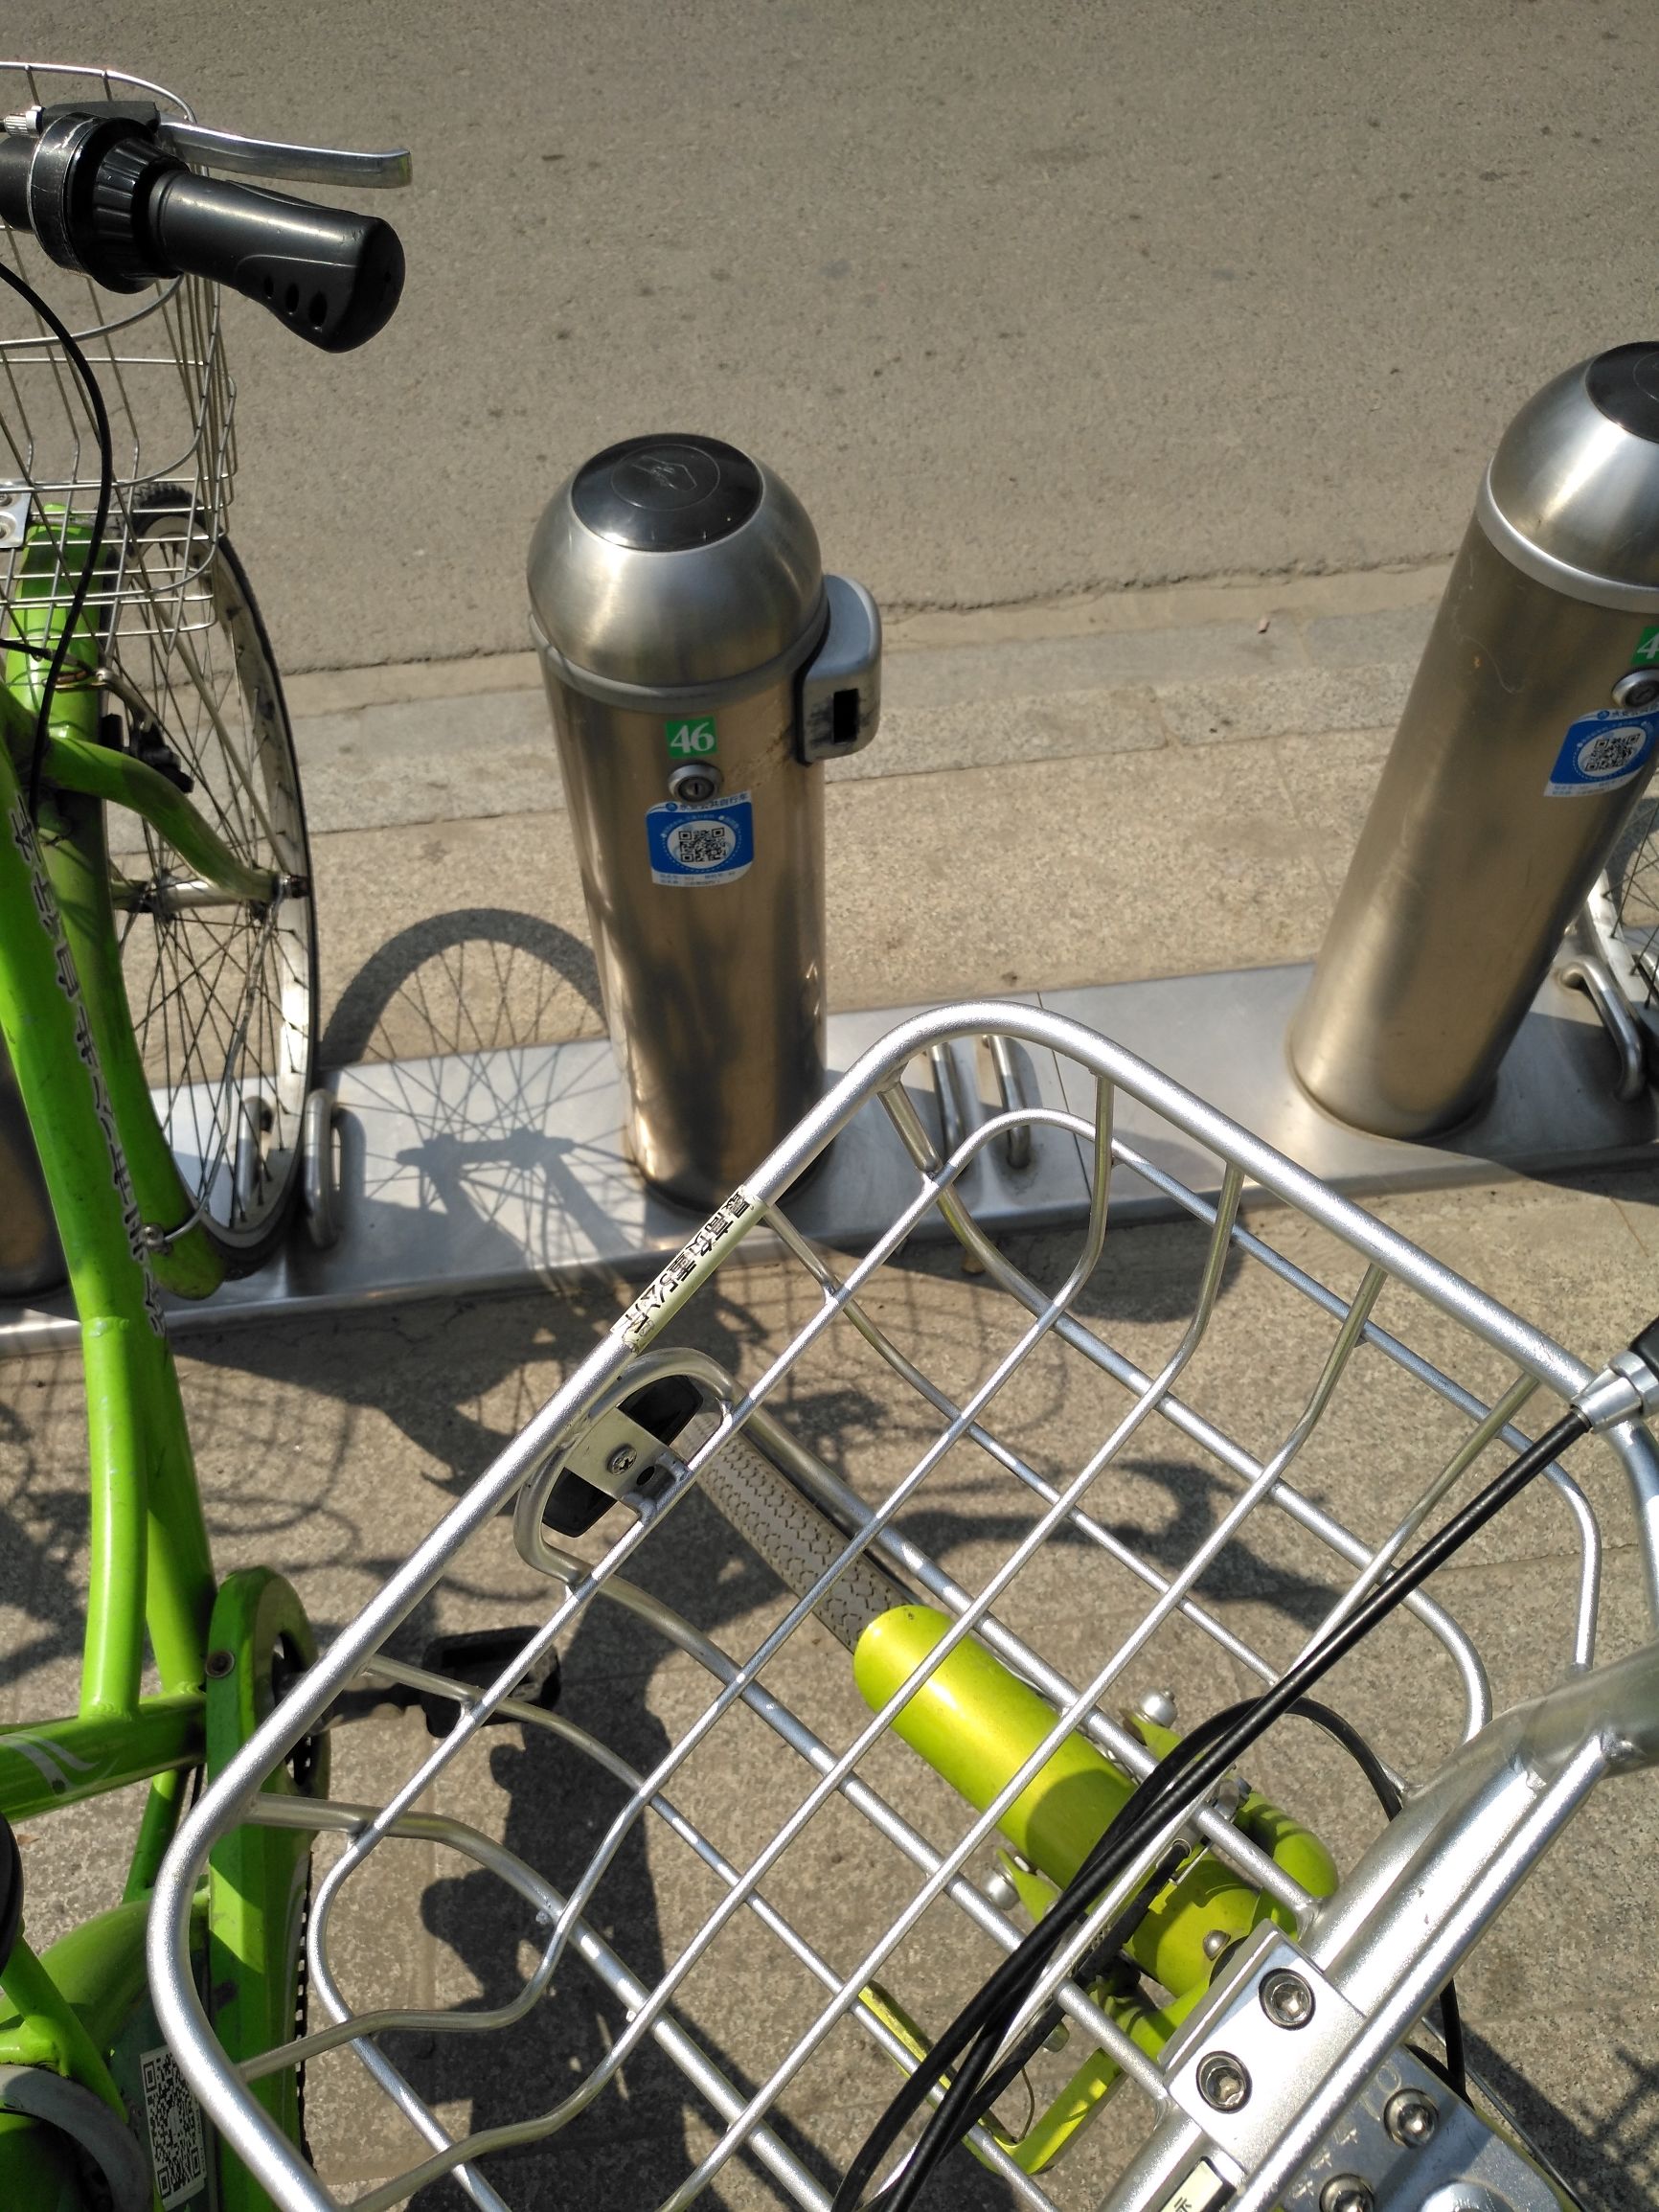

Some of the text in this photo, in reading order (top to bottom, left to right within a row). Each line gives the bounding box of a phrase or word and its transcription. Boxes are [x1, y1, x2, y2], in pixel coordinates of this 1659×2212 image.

[670, 722, 715, 753] 46
[625, 1191, 750, 1334] 最高负重5公斤
